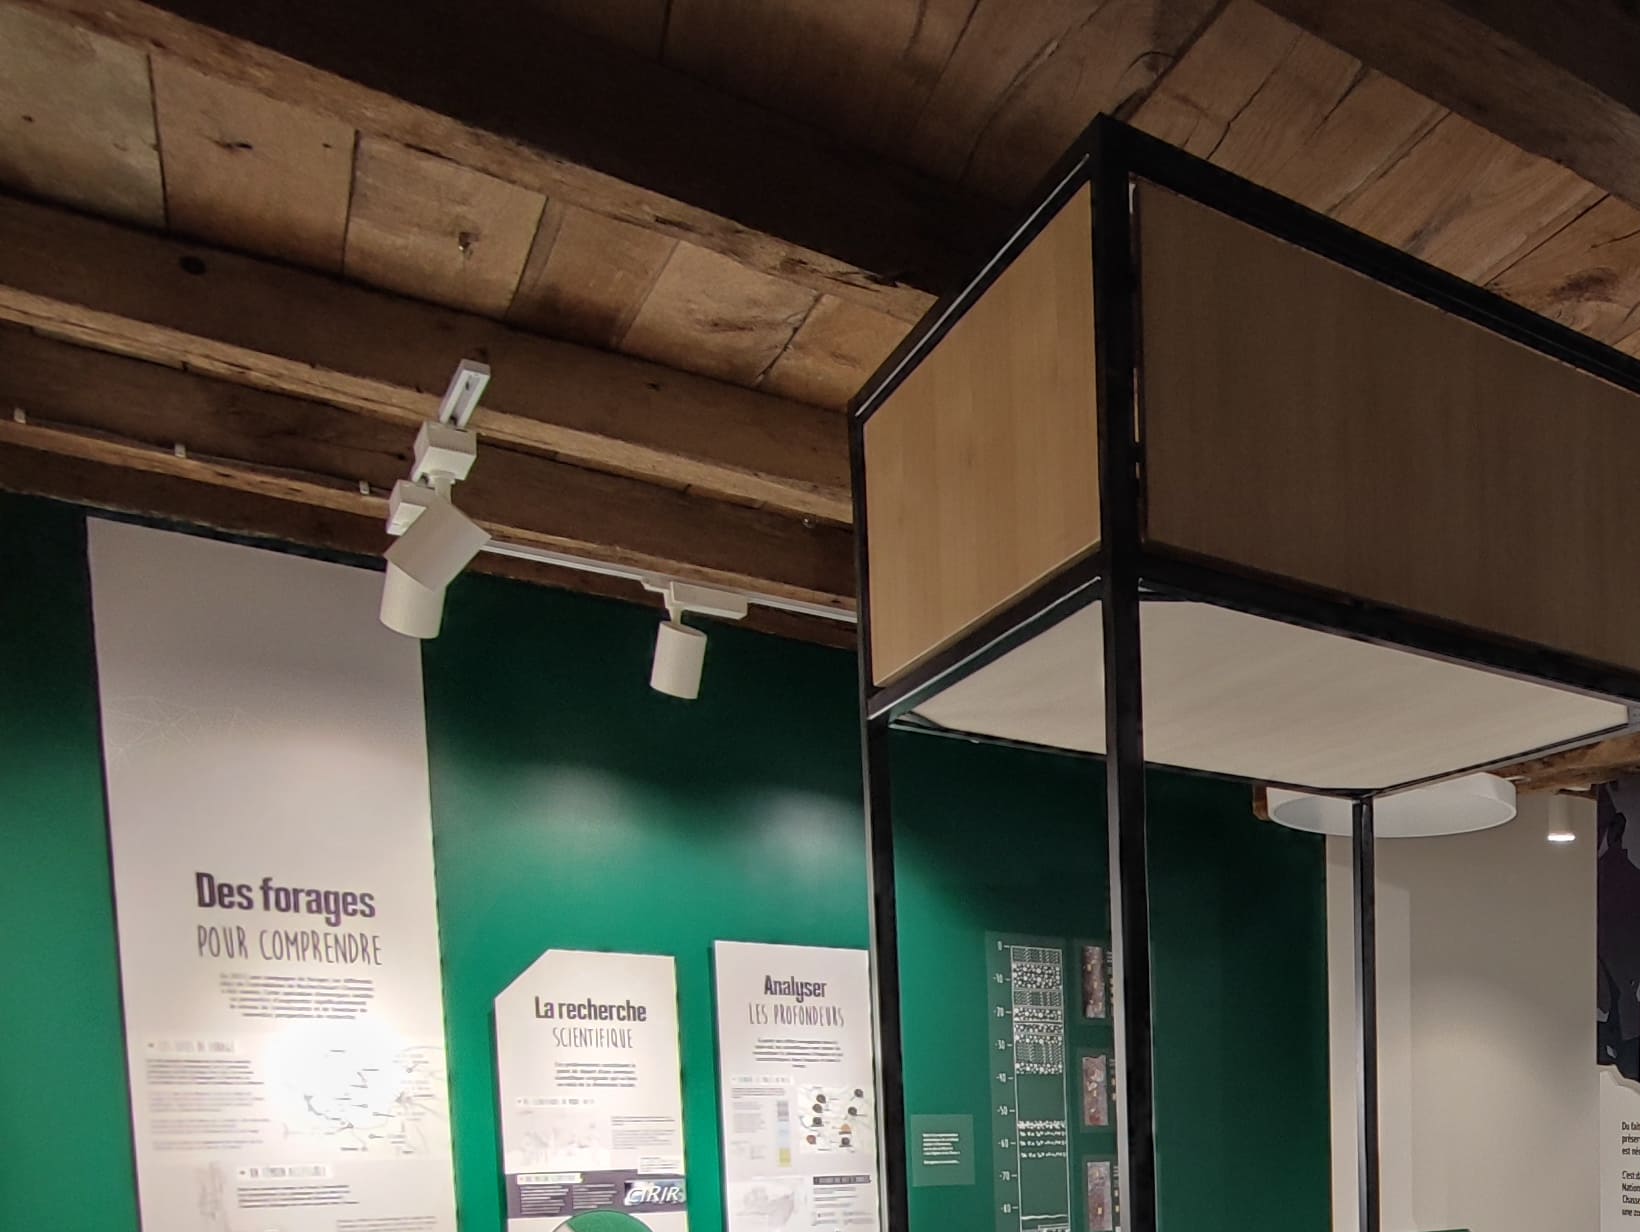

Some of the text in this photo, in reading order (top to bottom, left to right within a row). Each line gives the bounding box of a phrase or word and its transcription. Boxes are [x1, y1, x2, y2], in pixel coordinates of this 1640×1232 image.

[195, 872, 376, 927] Des forages
[197, 925, 383, 966] POUR COMPRENDRE
[764, 974, 828, 1003] Analyser
[534, 996, 647, 1022] La recherche
[748, 1003, 845, 1028] LES PROFONDEURS
[552, 1026, 634, 1049] SCIENTIFIQUE
